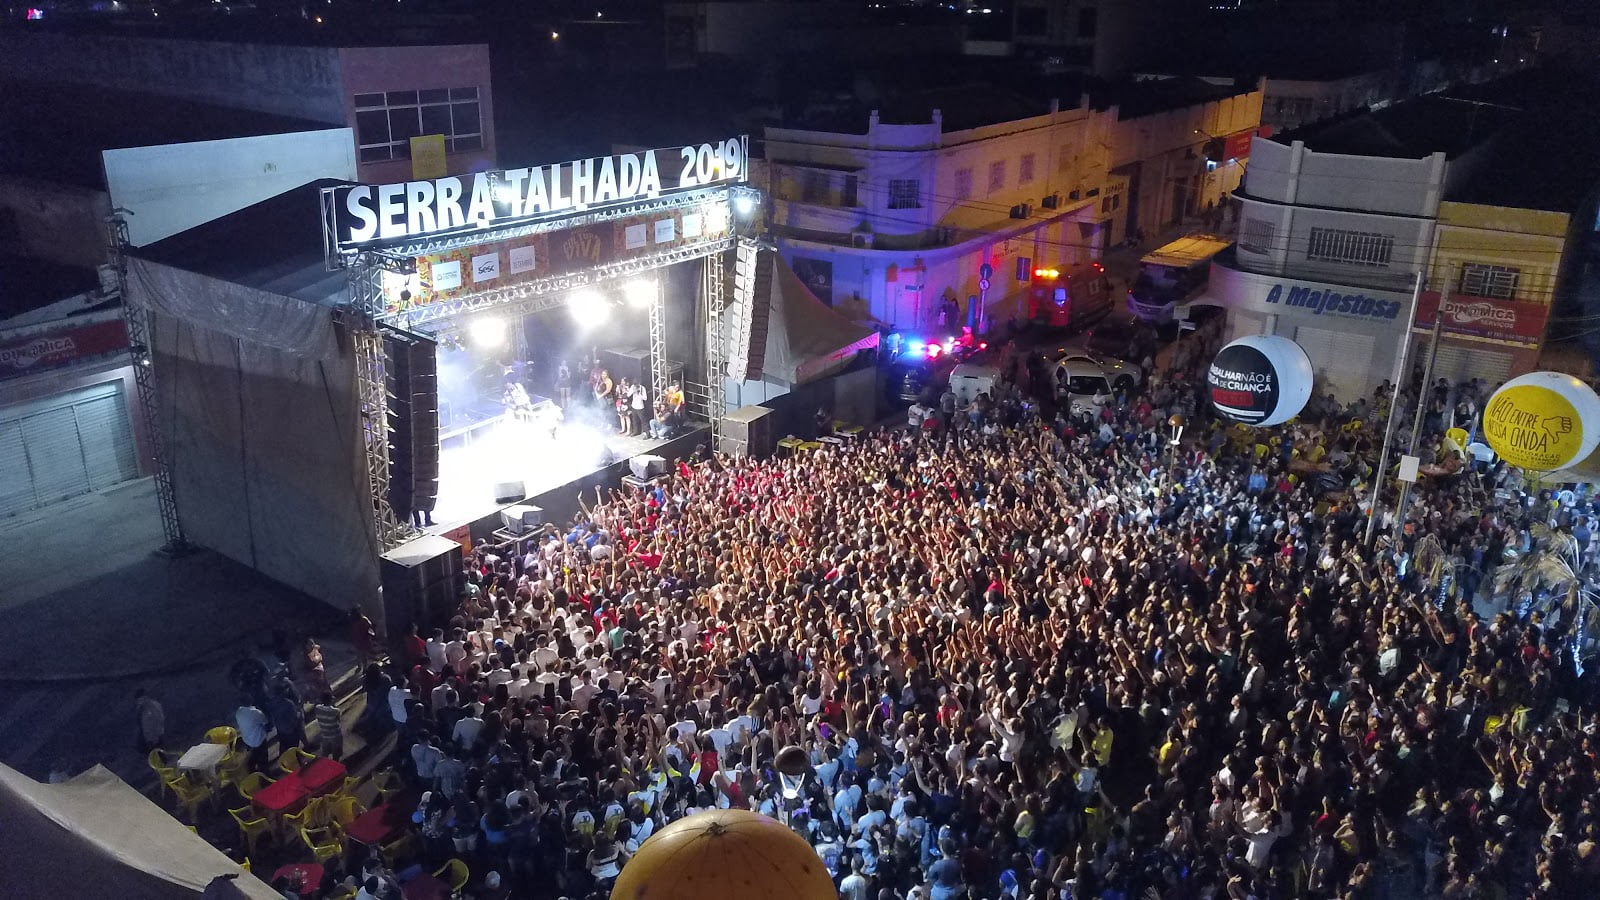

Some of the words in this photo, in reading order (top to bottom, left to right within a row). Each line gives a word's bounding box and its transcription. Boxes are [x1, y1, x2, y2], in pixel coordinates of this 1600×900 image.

[347, 171, 496, 242] SERRA
[505, 149, 662, 217] TALHADA
[680, 138, 741, 187] 2019
[563, 240, 601, 262] VIVA
[1266, 284, 1283, 304] A
[1285, 285, 1403, 320] Majestosa
[1227, 381, 1271, 393] CRIANÇA
[1241, 371, 1265, 383] NÃO
[1490, 396, 1515, 423] NÃO
[1510, 409, 1540, 430] ENTRE
[1510, 427, 1547, 452] ONDA
